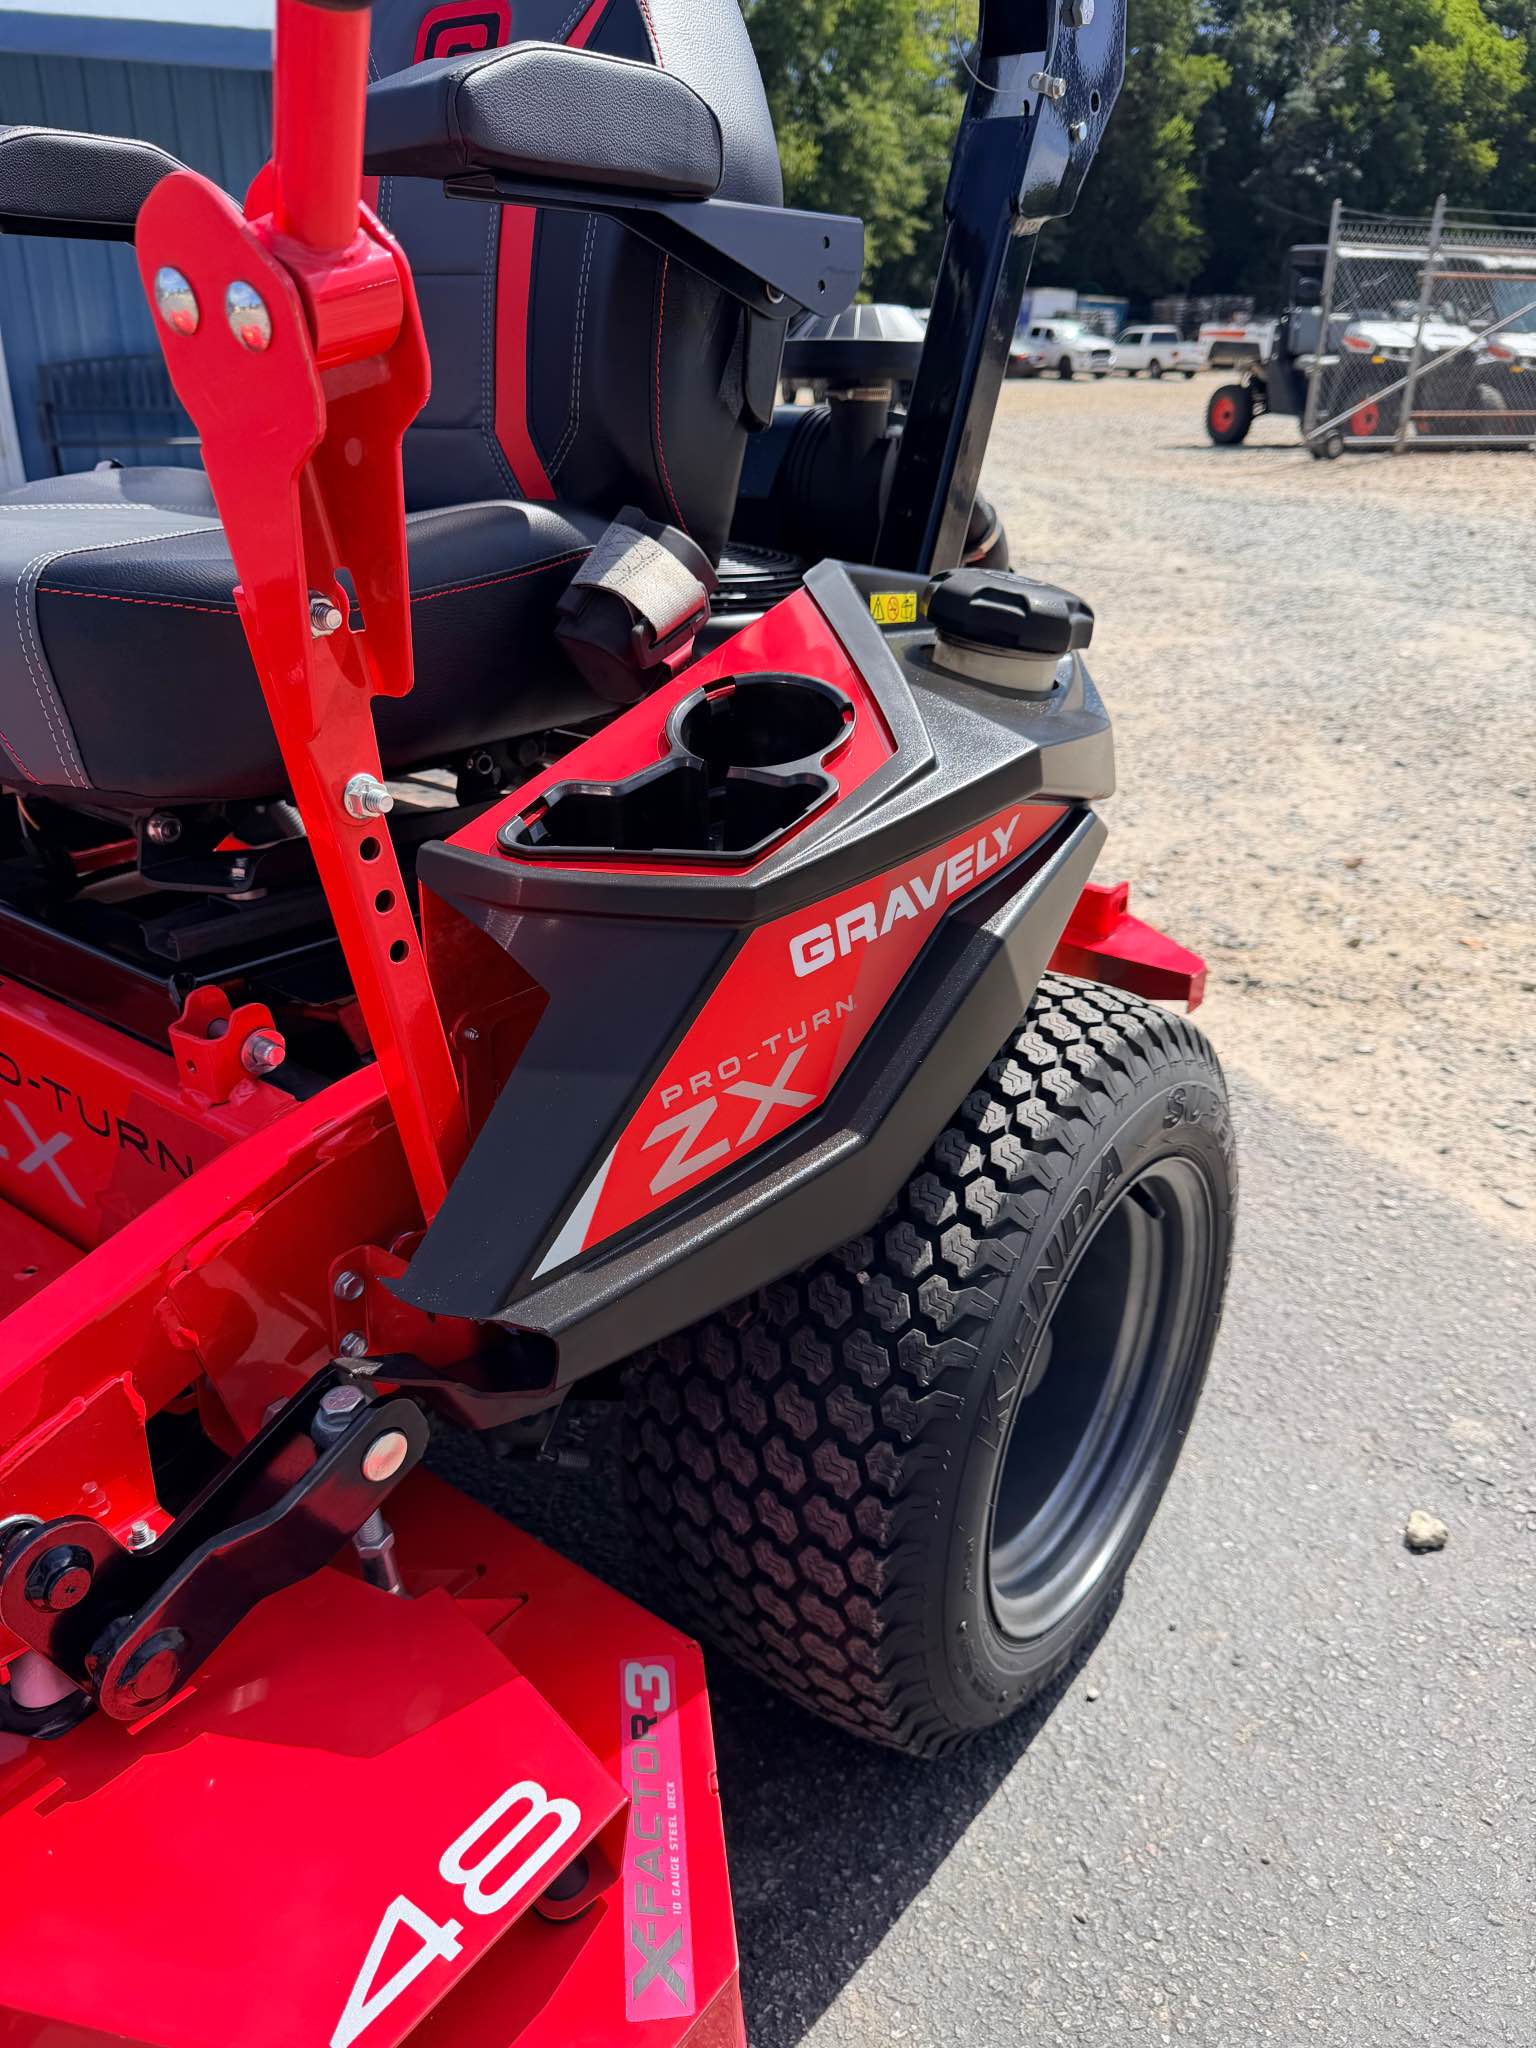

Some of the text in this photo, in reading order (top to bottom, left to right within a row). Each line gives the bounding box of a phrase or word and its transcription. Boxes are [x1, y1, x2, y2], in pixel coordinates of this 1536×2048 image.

[790, 813, 1020, 978] GRAVELY
[640, 1043, 818, 1196] ZX
[660, 995, 855, 1109] PRO-TURN
[977, 1143, 1123, 1451] KENDA
[329, 1780, 582, 2048] 48
[666, 1780, 682, 1915] 10 GAUGE STEEL DECK
